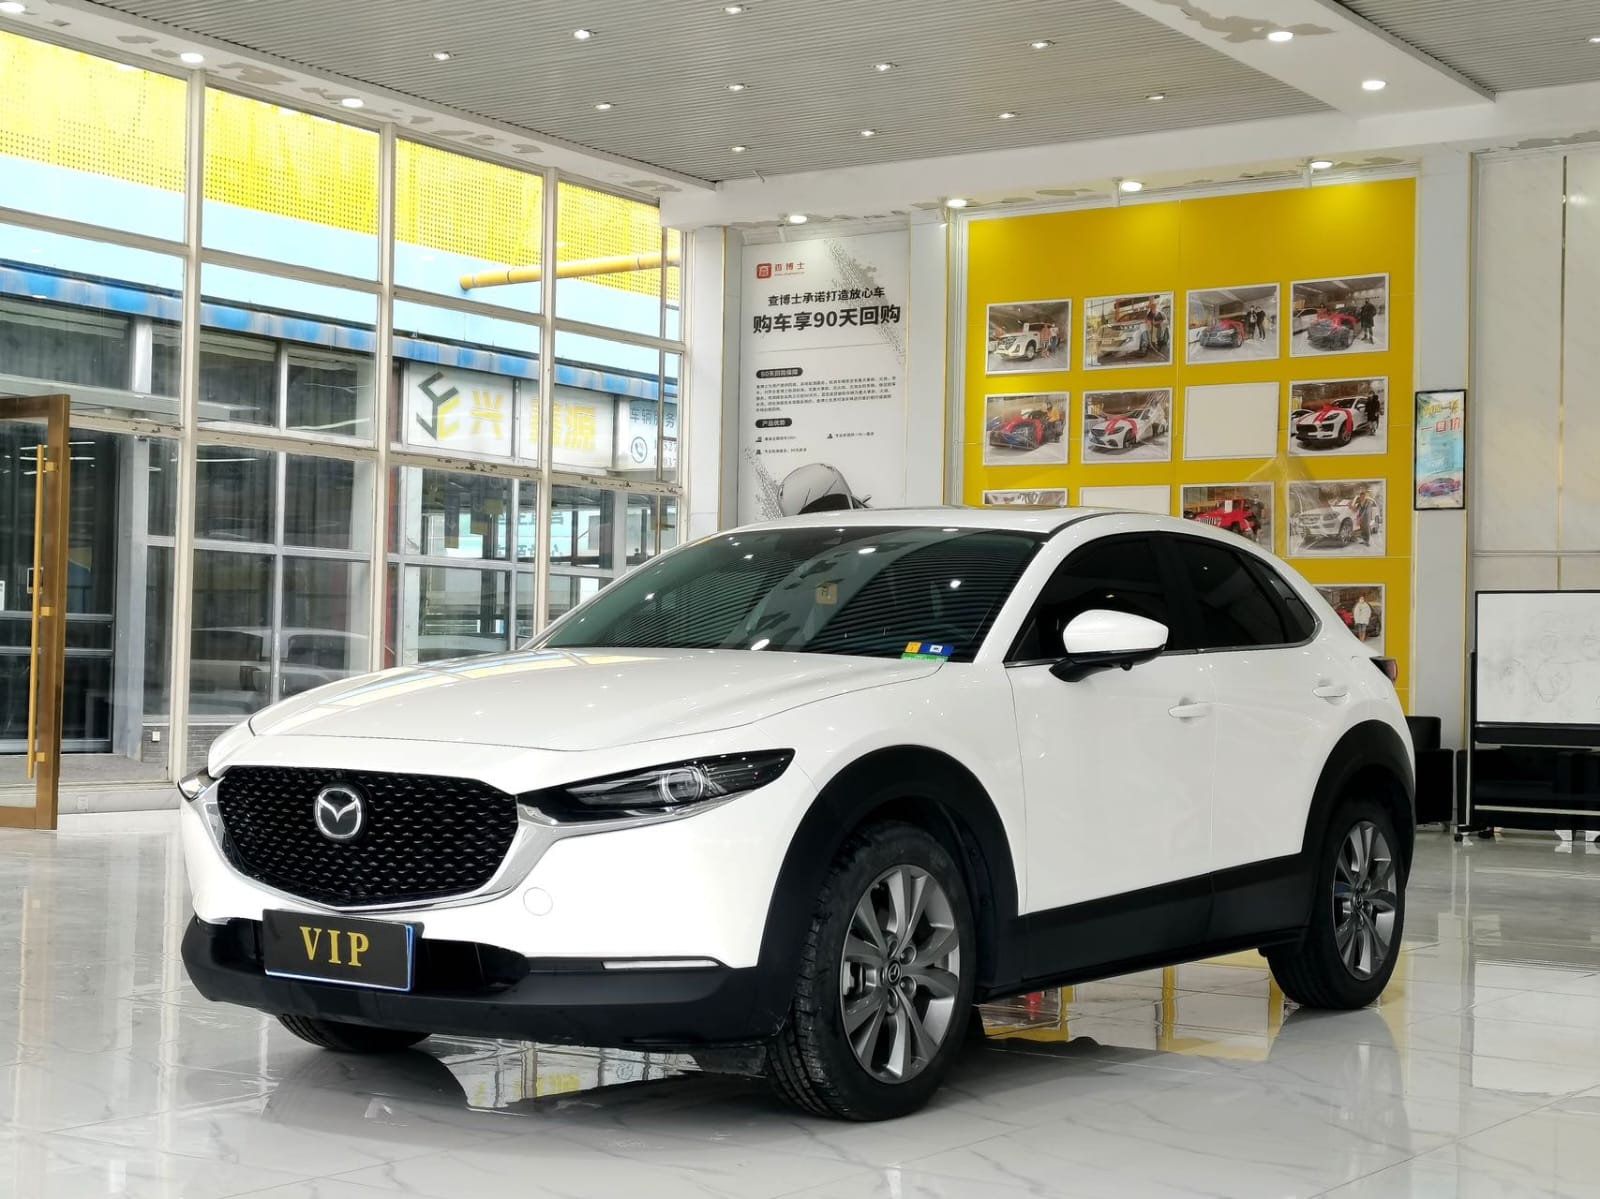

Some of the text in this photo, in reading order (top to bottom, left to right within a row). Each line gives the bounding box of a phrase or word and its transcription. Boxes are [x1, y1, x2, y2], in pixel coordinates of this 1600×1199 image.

[767, 286, 886, 306] 查博士承诺打造放心车
[753, 304, 901, 334] 购车享90天回购
[299, 926, 369, 966] VIP
